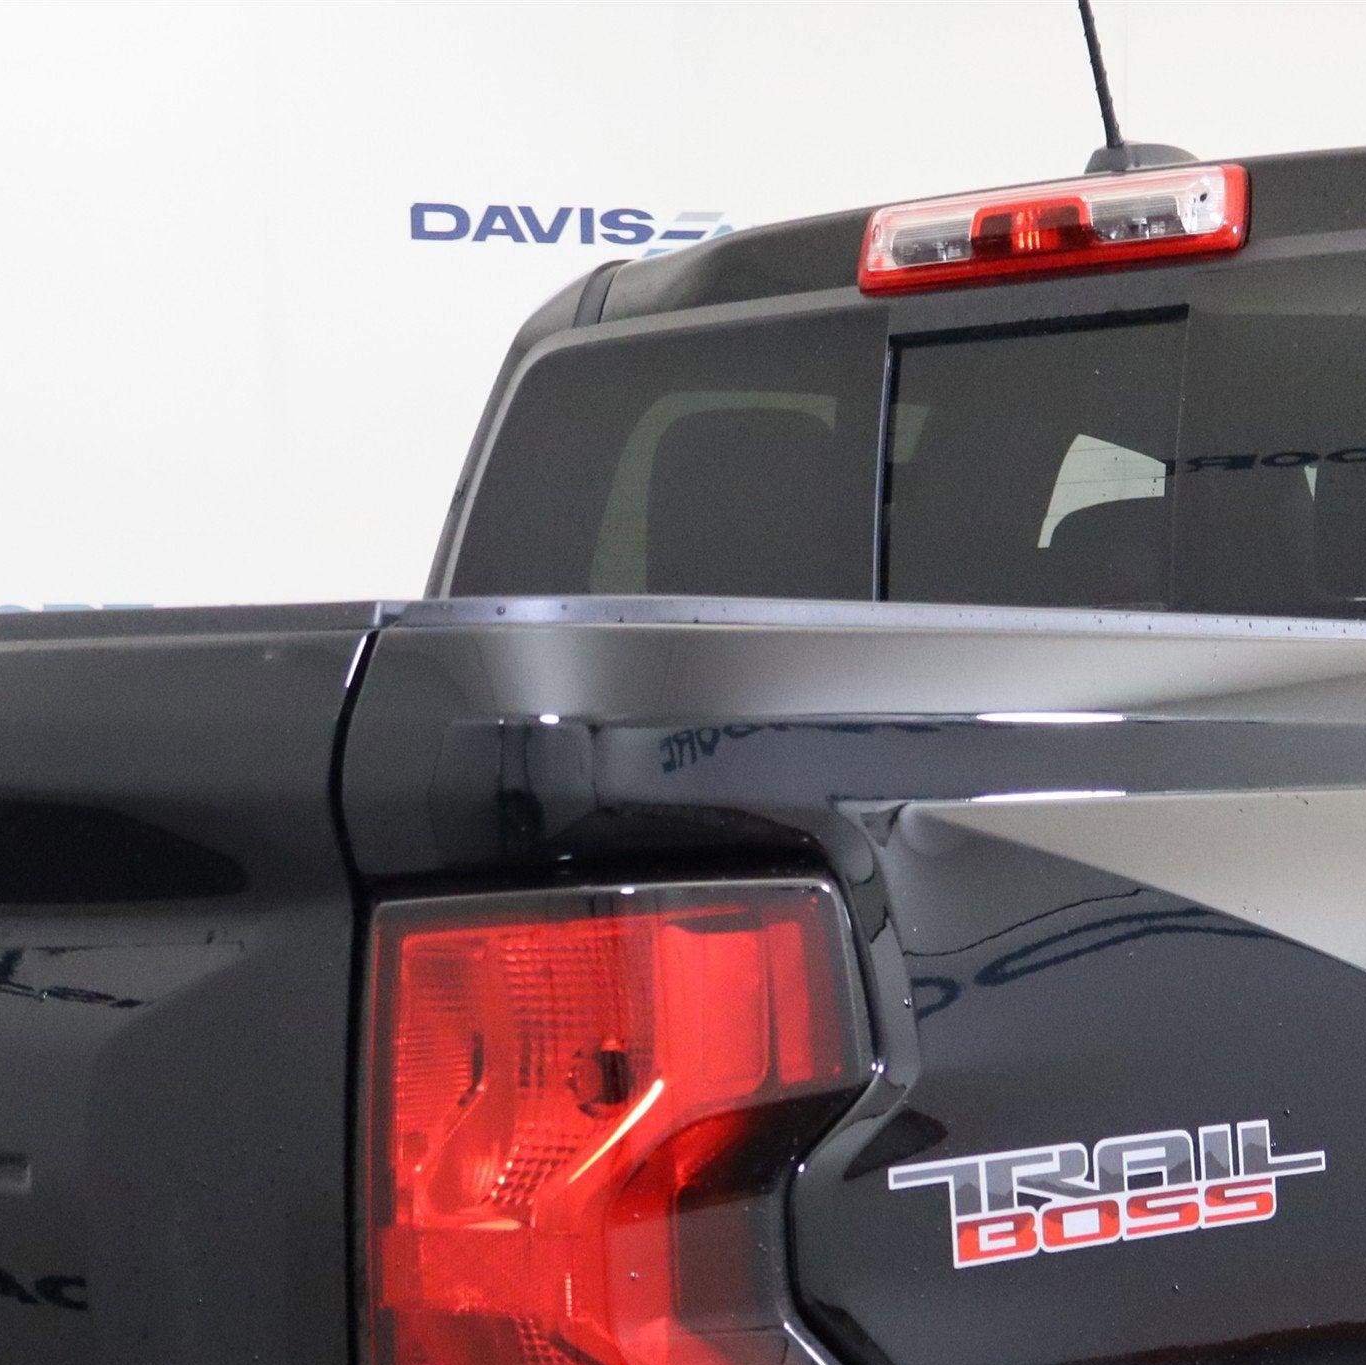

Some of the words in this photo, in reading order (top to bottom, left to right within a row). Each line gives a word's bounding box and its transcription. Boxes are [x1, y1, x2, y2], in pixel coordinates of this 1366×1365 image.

[410, 202, 656, 246] DAVIS
[887, 1119, 1326, 1217] TRAIL
[952, 1177, 1277, 1269] BOSS
